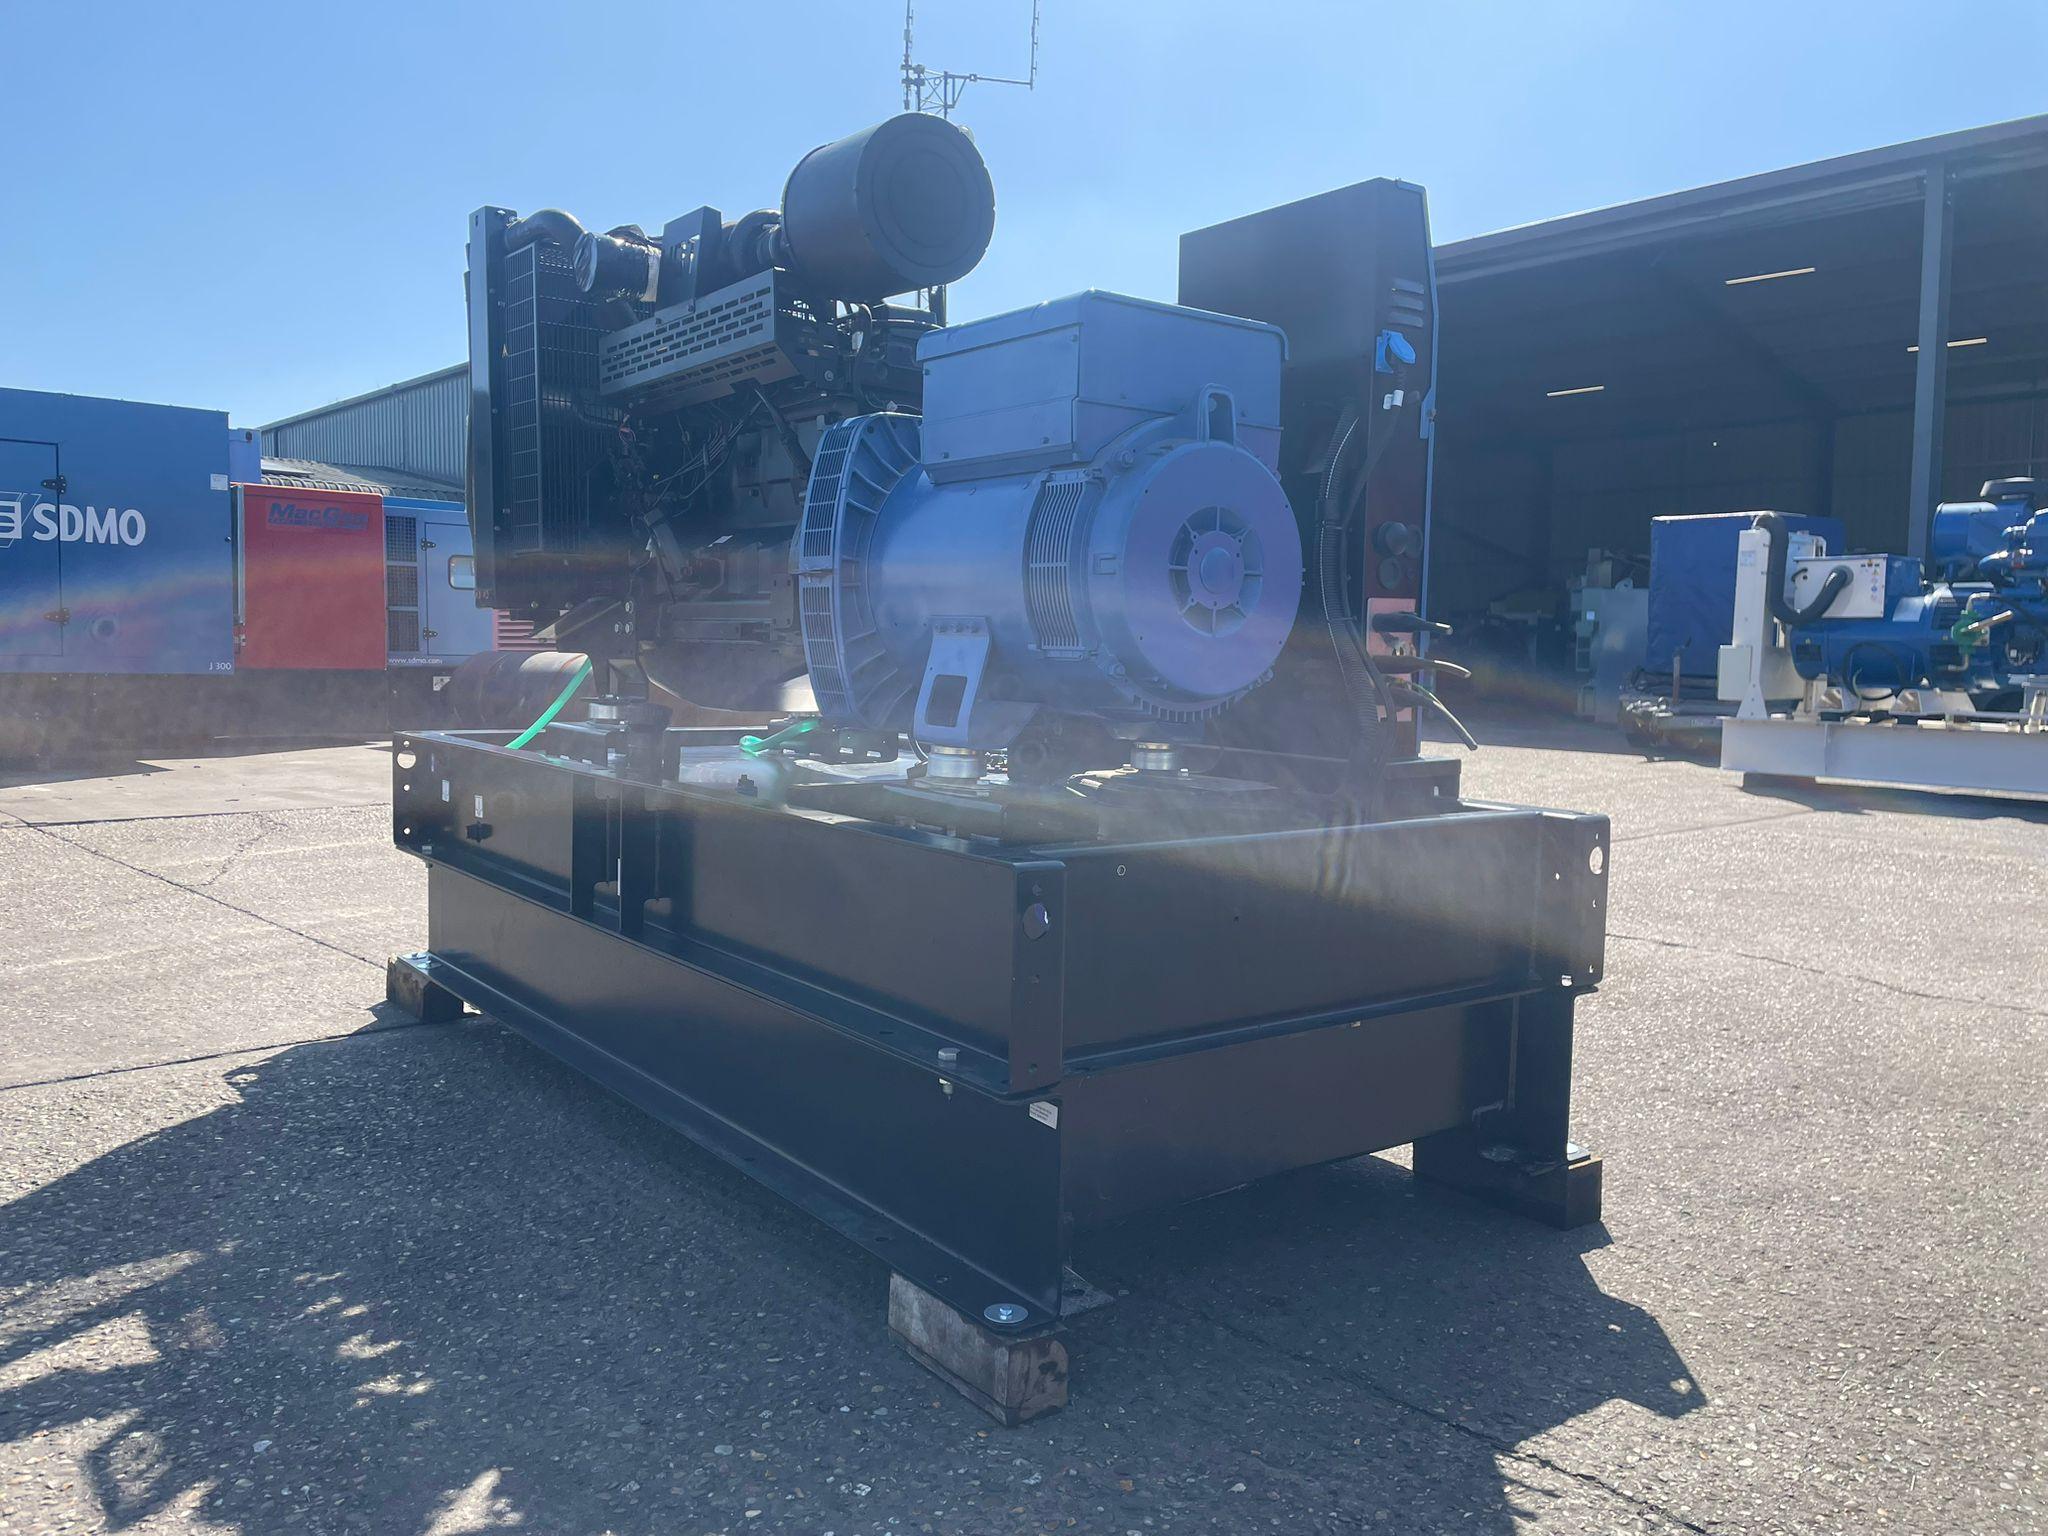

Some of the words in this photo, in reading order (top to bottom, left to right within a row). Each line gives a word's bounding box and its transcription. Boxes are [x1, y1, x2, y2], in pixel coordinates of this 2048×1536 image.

[32, 502, 146, 546] SDMO
[388, 657, 443, 665] www.sdmo.com
[215, 662, 232, 671] 300
